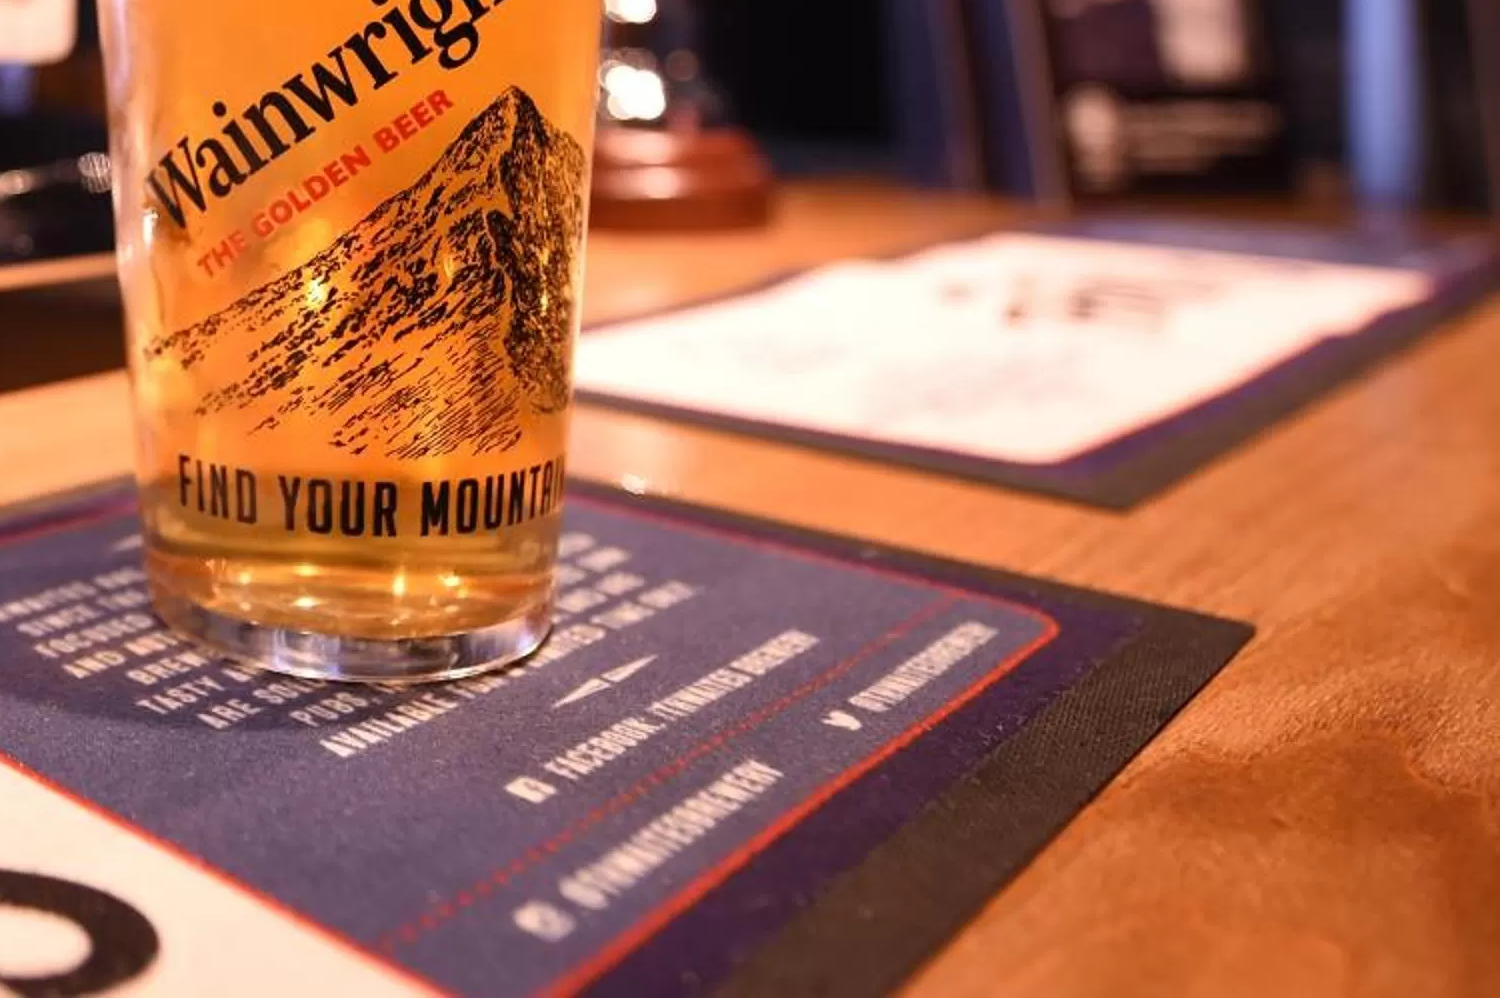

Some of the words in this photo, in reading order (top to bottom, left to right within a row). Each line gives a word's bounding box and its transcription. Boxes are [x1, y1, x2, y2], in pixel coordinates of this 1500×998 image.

[196, 229, 247, 278] THE
[252, 144, 372, 240] GOLDEN
[373, 89, 454, 154] BEER
[177, 454, 258, 525] FIND
[278, 475, 398, 538] YOUR
[136, 675, 225, 715] TASTY
[197, 698, 263, 730] ARE
[319, 692, 460, 758] AVAILABLE
